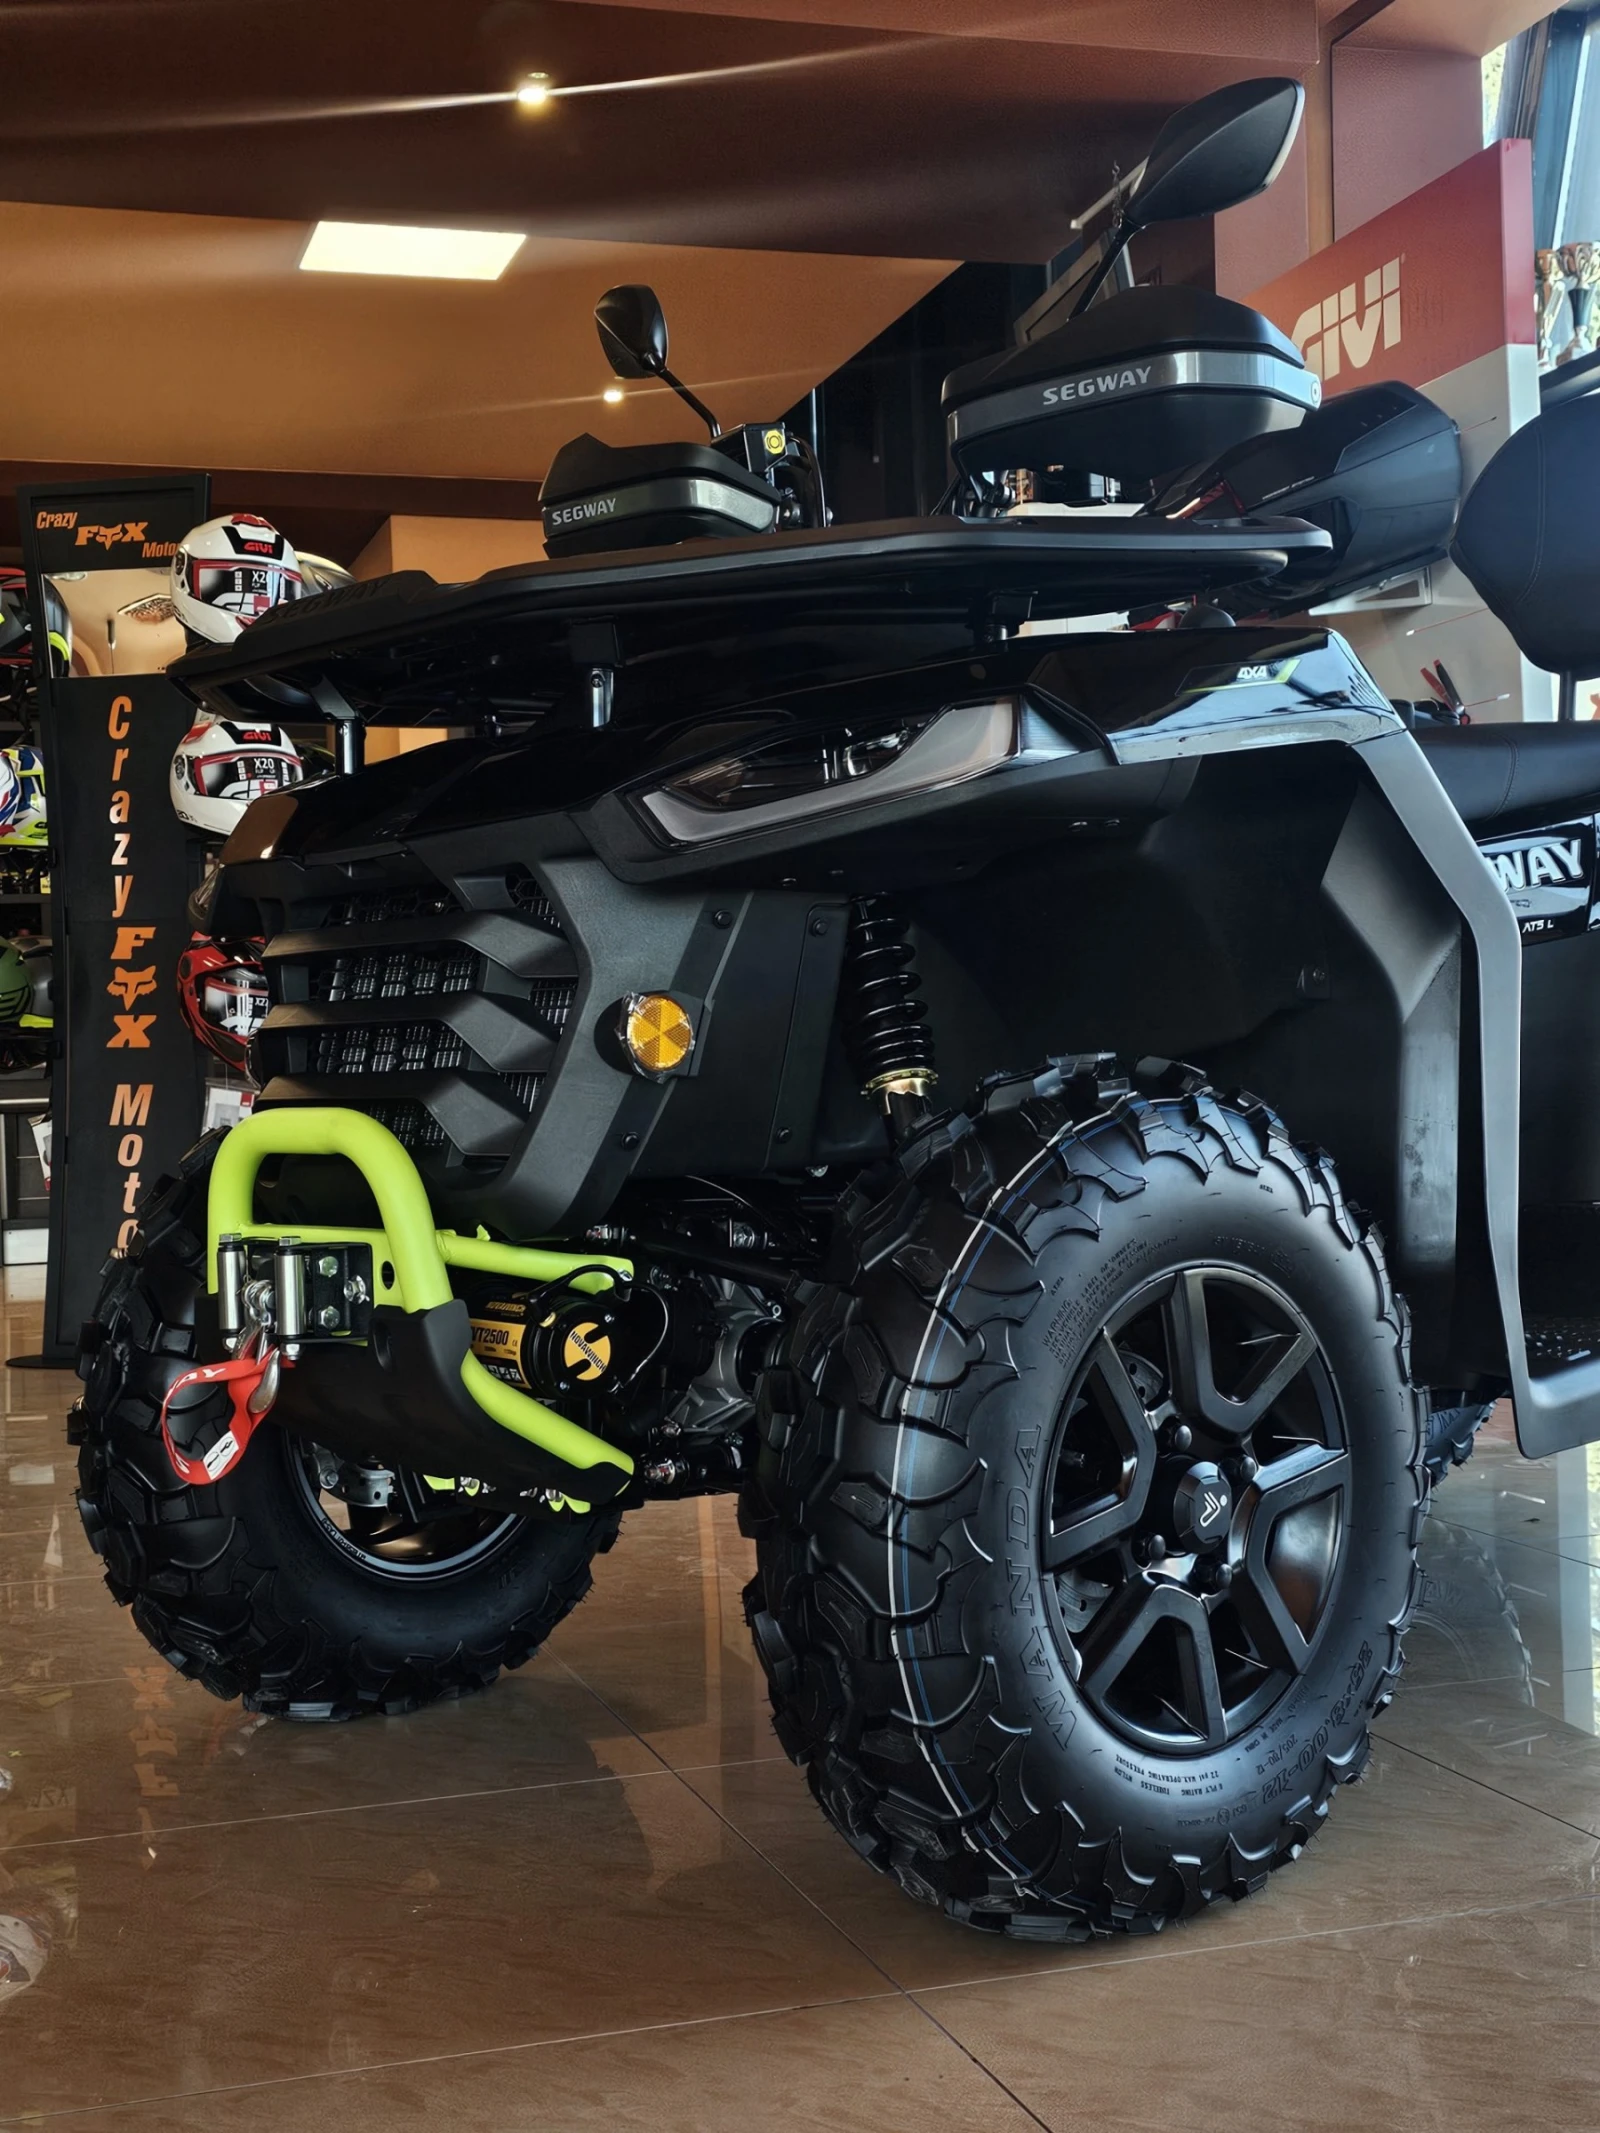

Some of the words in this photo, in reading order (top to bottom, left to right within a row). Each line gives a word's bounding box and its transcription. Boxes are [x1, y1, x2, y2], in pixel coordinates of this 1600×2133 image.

[1042, 366, 1152, 406] SEGWAY
[36, 511, 78, 529] Crazy
[552, 498, 616, 526] SEGWAY
[142, 542, 179, 558] Moto
[244, 542, 273, 554] GIVI
[254, 758, 275, 769] X20
[108, 695, 132, 919] Crazy
[1547, 920, 1554, 929] L
[570, 1330, 607, 1373] NOVAWINCH
[1007, 1424, 1078, 1751] WANDA
[1256, 1734, 1298, 1774] 205/80-12
